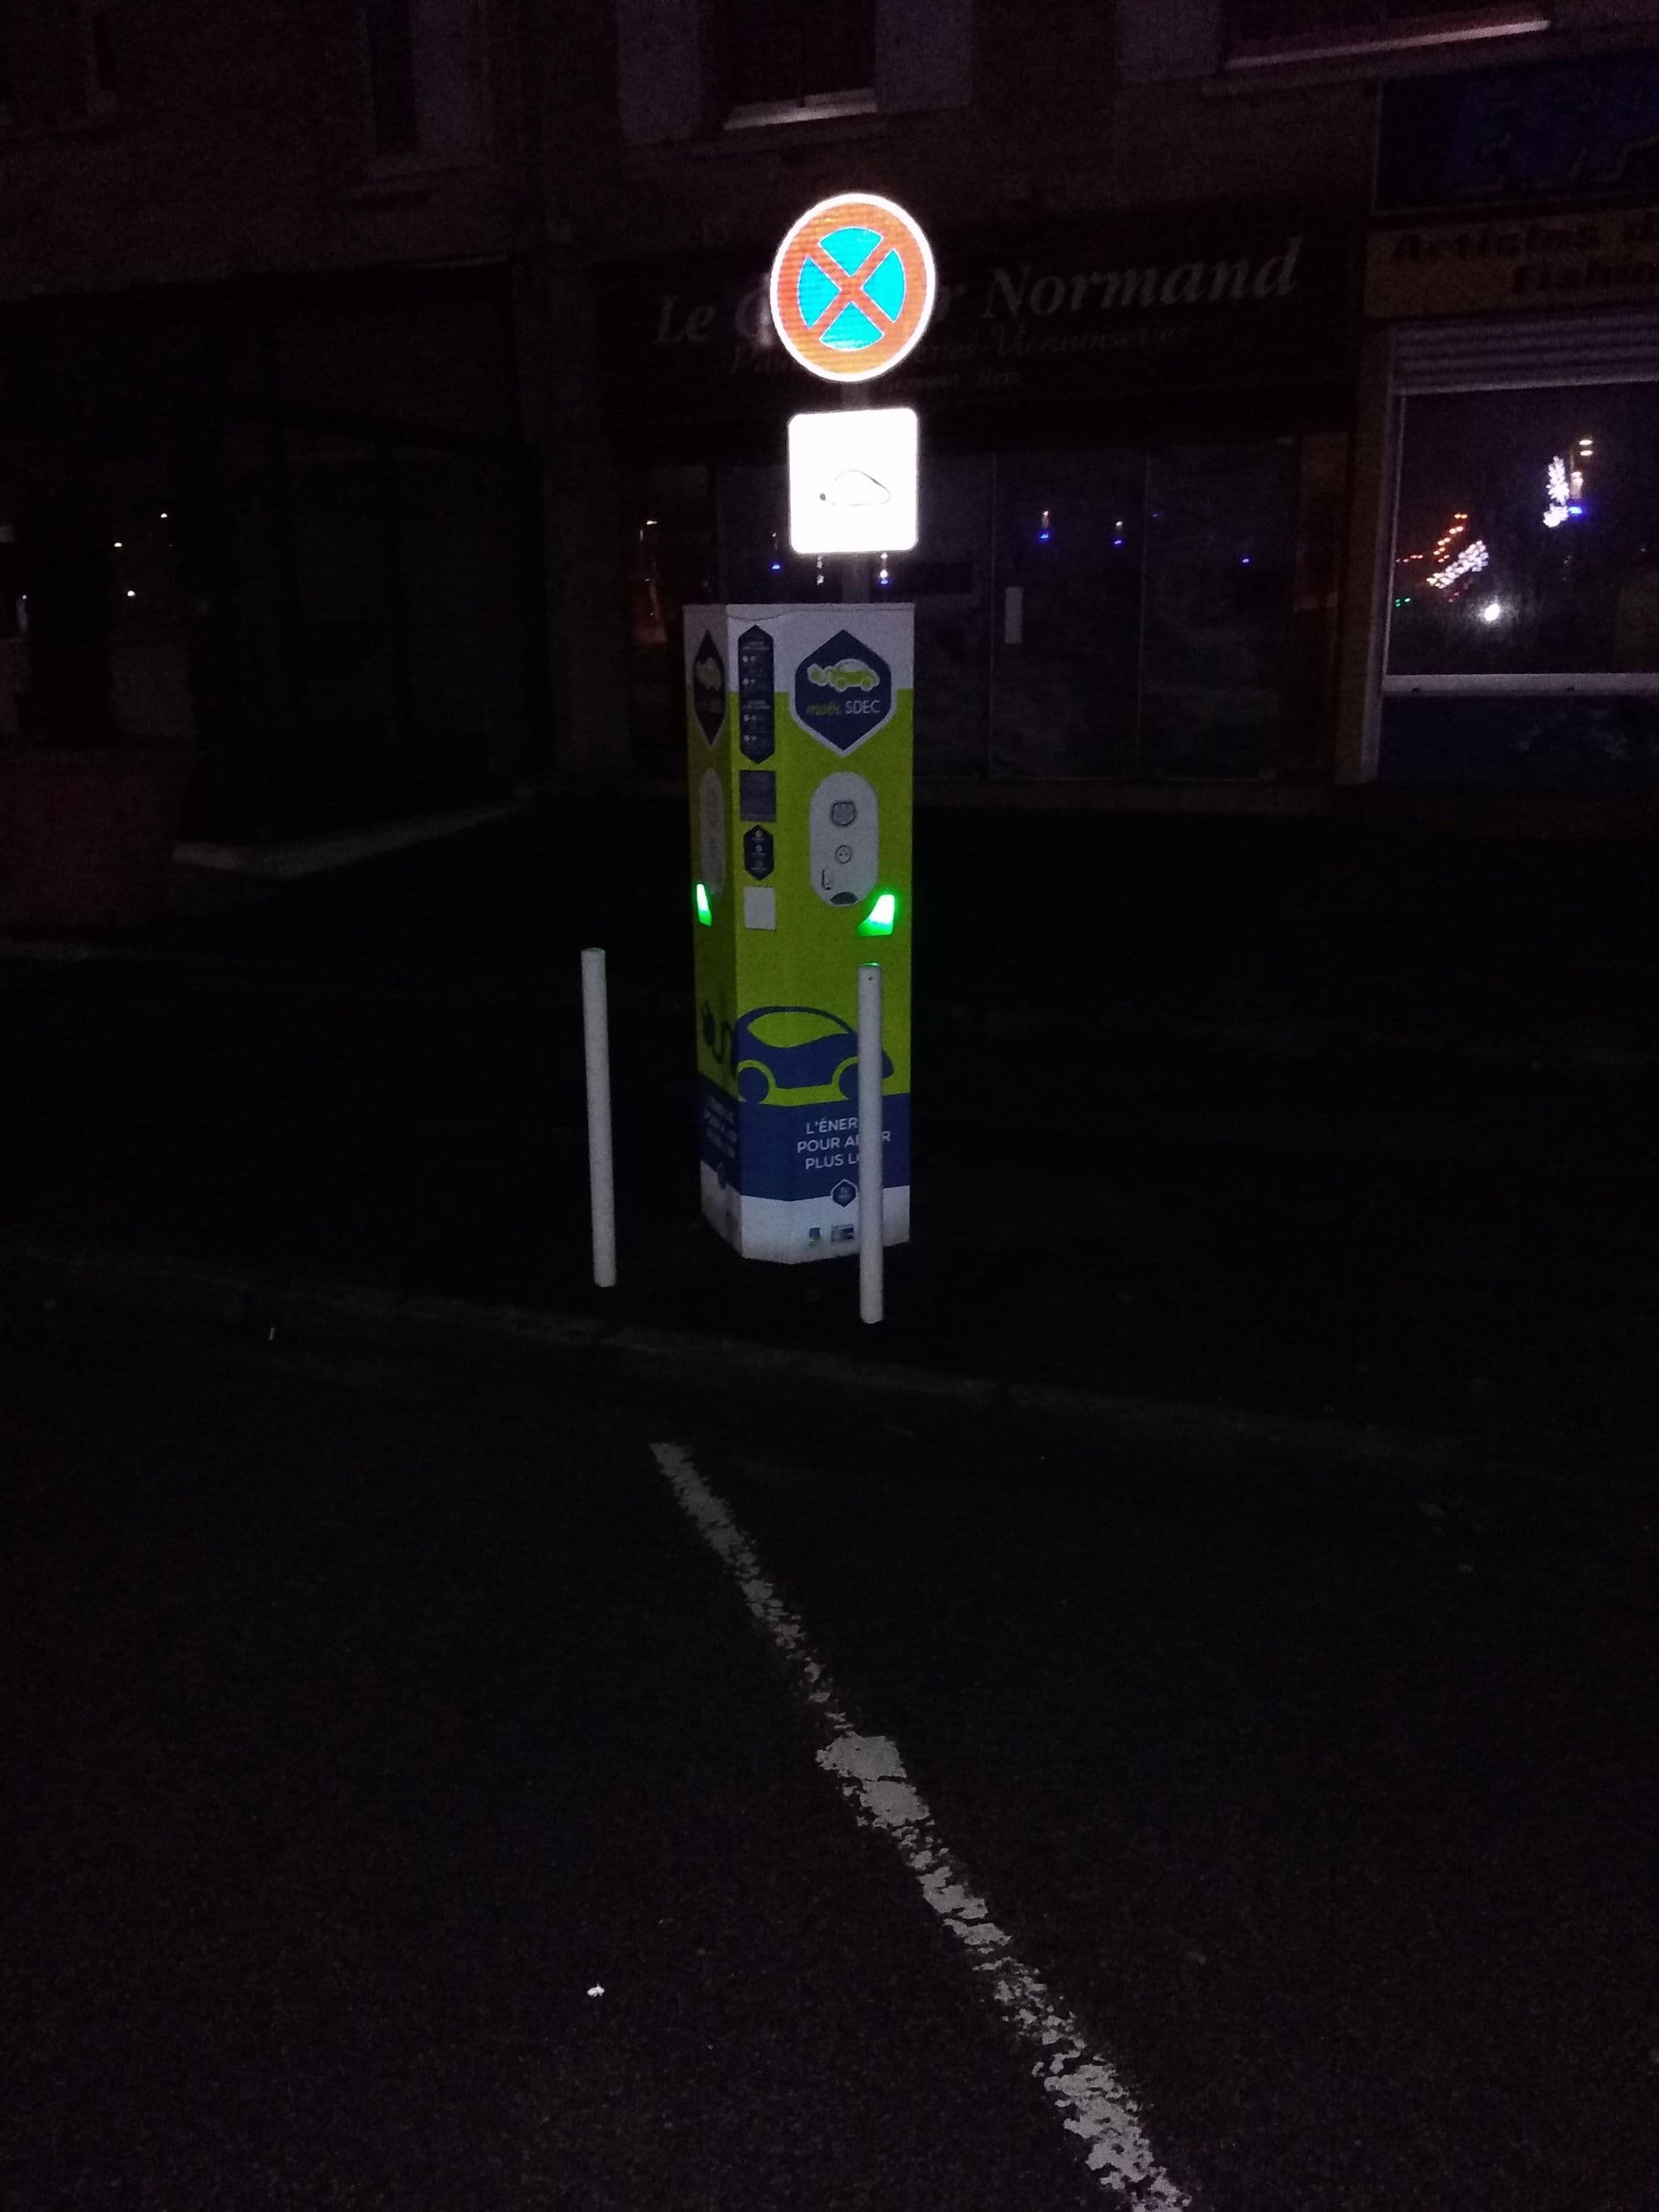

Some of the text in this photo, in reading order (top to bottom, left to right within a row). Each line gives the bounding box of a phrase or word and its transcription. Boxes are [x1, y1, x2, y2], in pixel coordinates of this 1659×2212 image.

[650, 294, 714, 345] Le
[980, 233, 1304, 319] Normand
[844, 699, 881, 715] SDEC
[806, 1117, 859, 1134] L'ÉNER
[797, 1136, 841, 1153] POUR
[805, 1153, 844, 1170] PLUS
